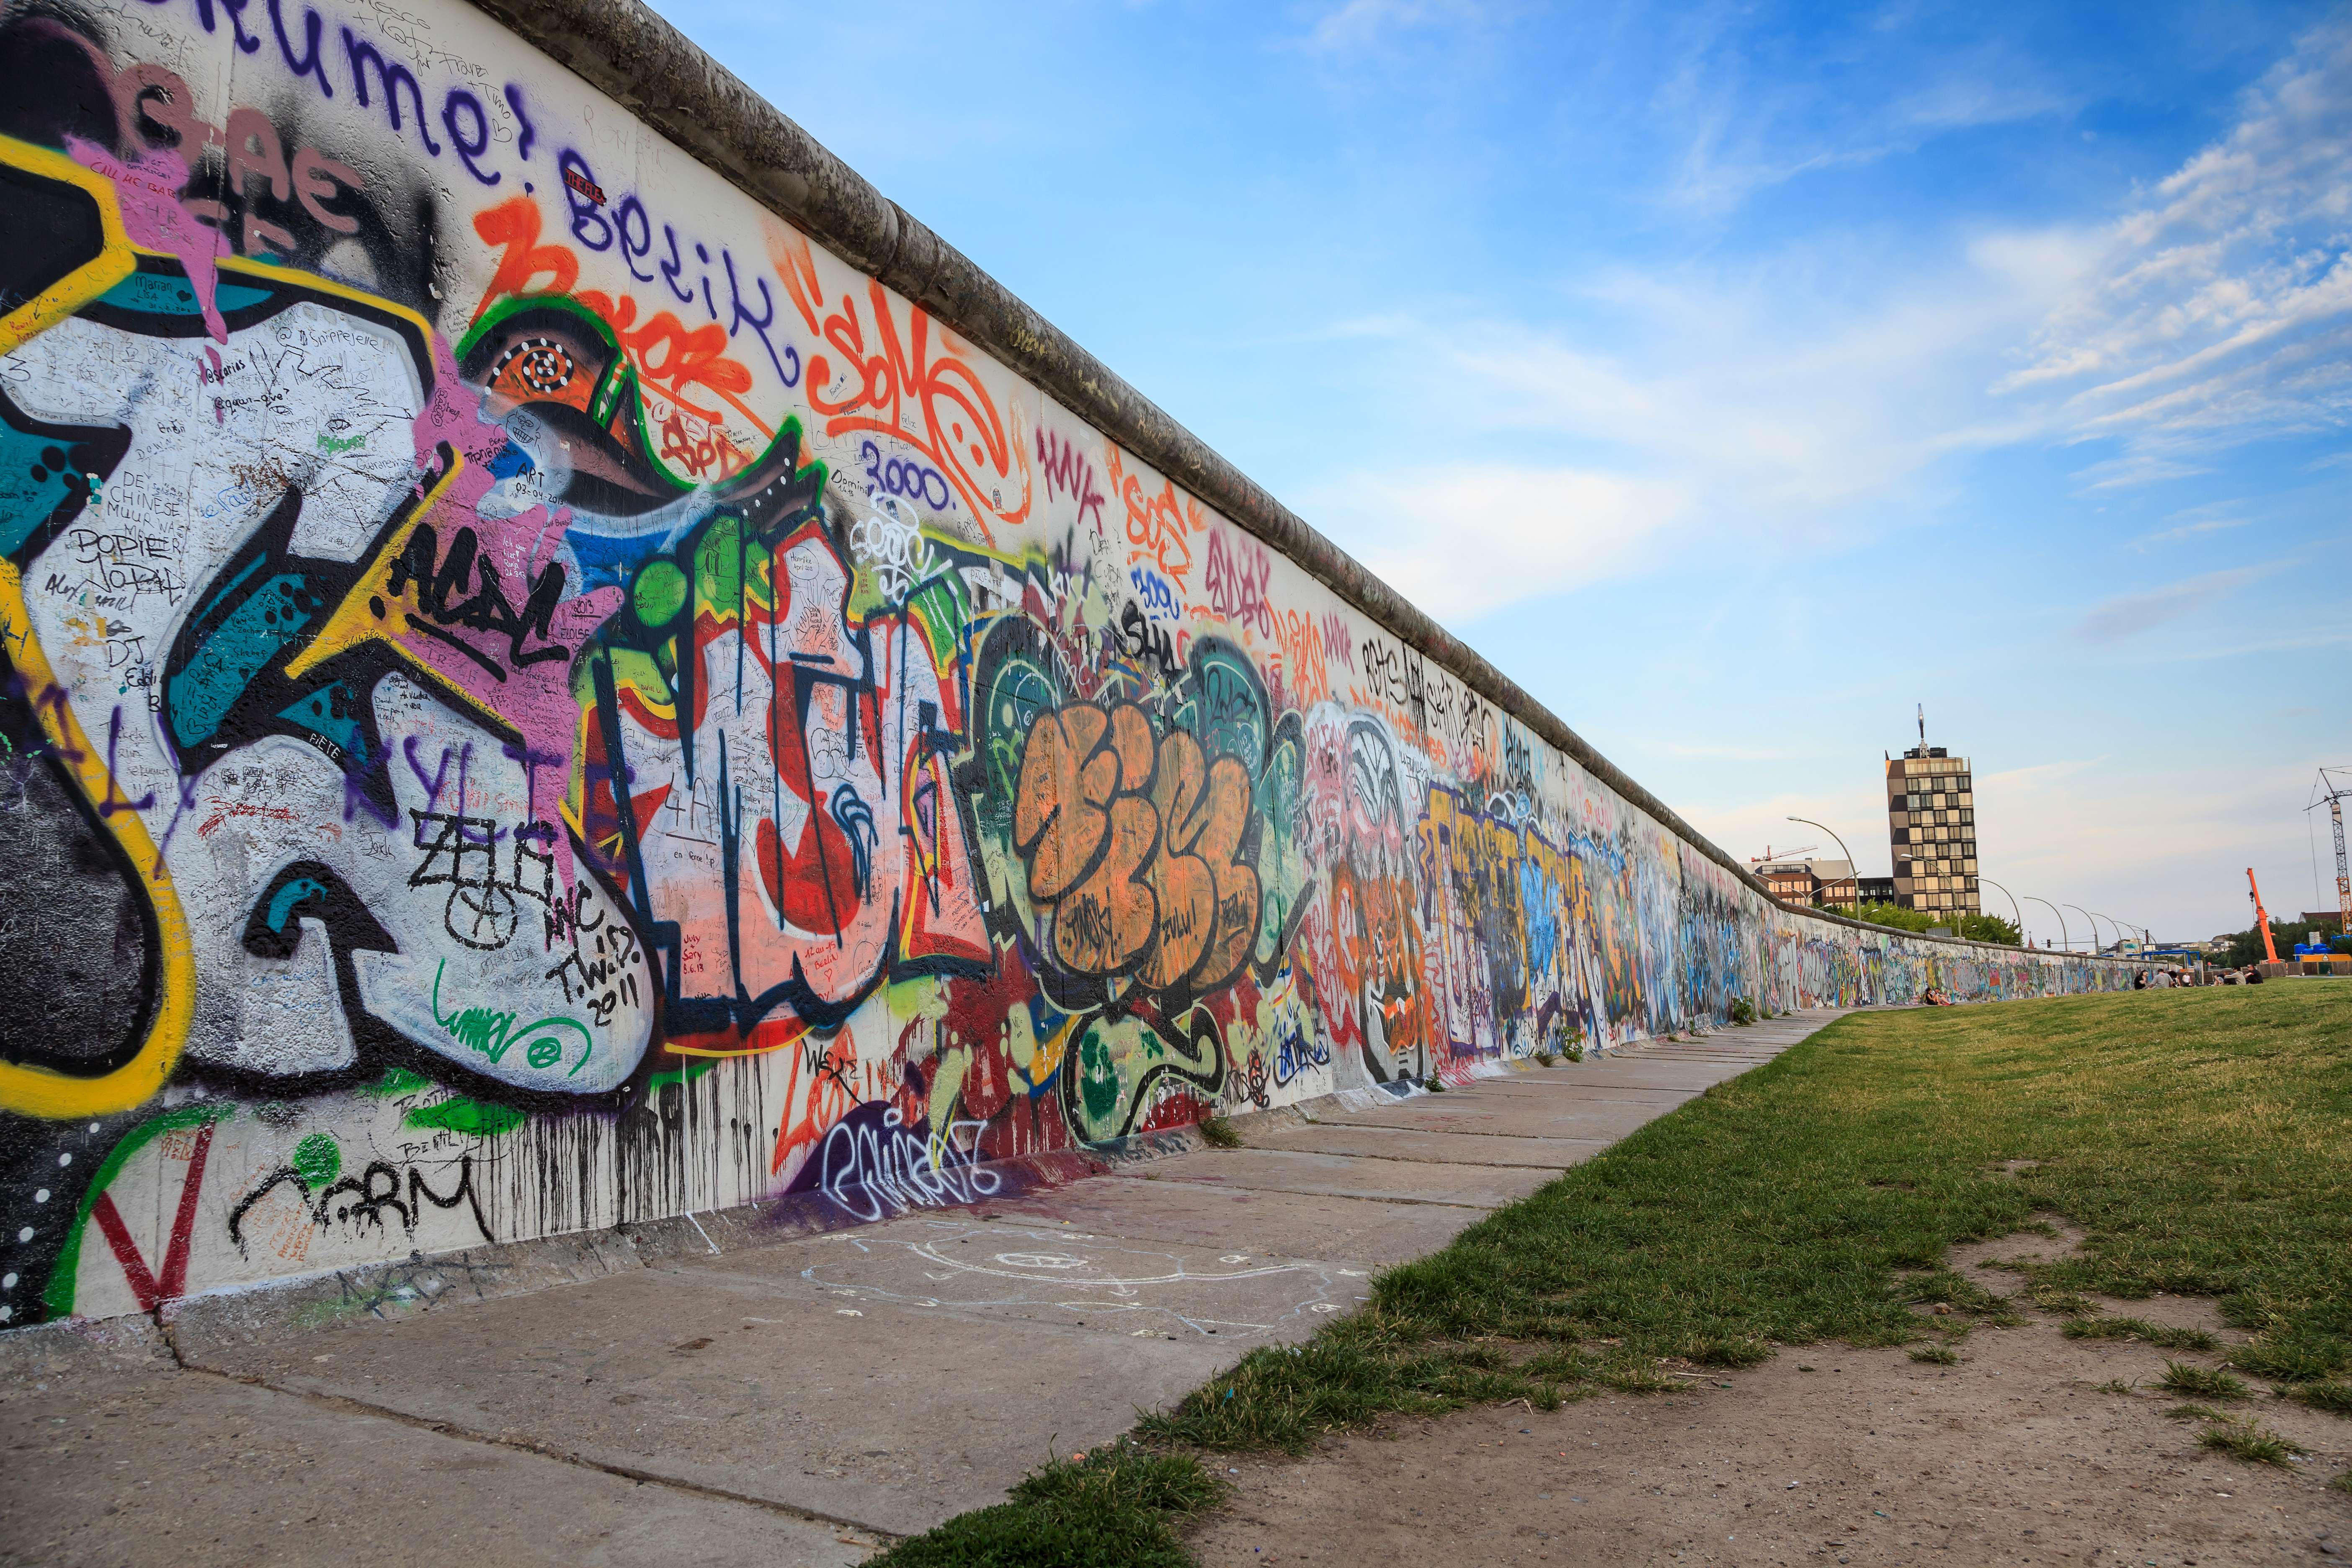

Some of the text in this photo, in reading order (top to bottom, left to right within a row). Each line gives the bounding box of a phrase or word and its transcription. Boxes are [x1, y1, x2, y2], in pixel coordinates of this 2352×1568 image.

[479, 83, 511, 119] Timo
[90, 162, 117, 180] CALL
[123, 173, 142, 188] ME
[565, 170, 585, 193] THE
[136, 276, 173, 293] Marian
[901, 413, 917, 429] Felix
[124, 471, 144, 489] DE
[516, 462, 545, 487] ART
[831, 469, 872, 498] Dominik
[516, 482, 564, 505] 03-04-2013
[503, 535, 513, 548] Ich
[790, 552, 812, 565] Henrike
[45, 573, 87, 602] Alex
[826, 585, 843, 596] Dominik
[106, 635, 145, 668] DJ
[640, 684, 655, 693] DANIEL
[674, 851, 683, 859] en
[683, 934, 701, 945] July
[586, 972, 639, 1027] 2011
